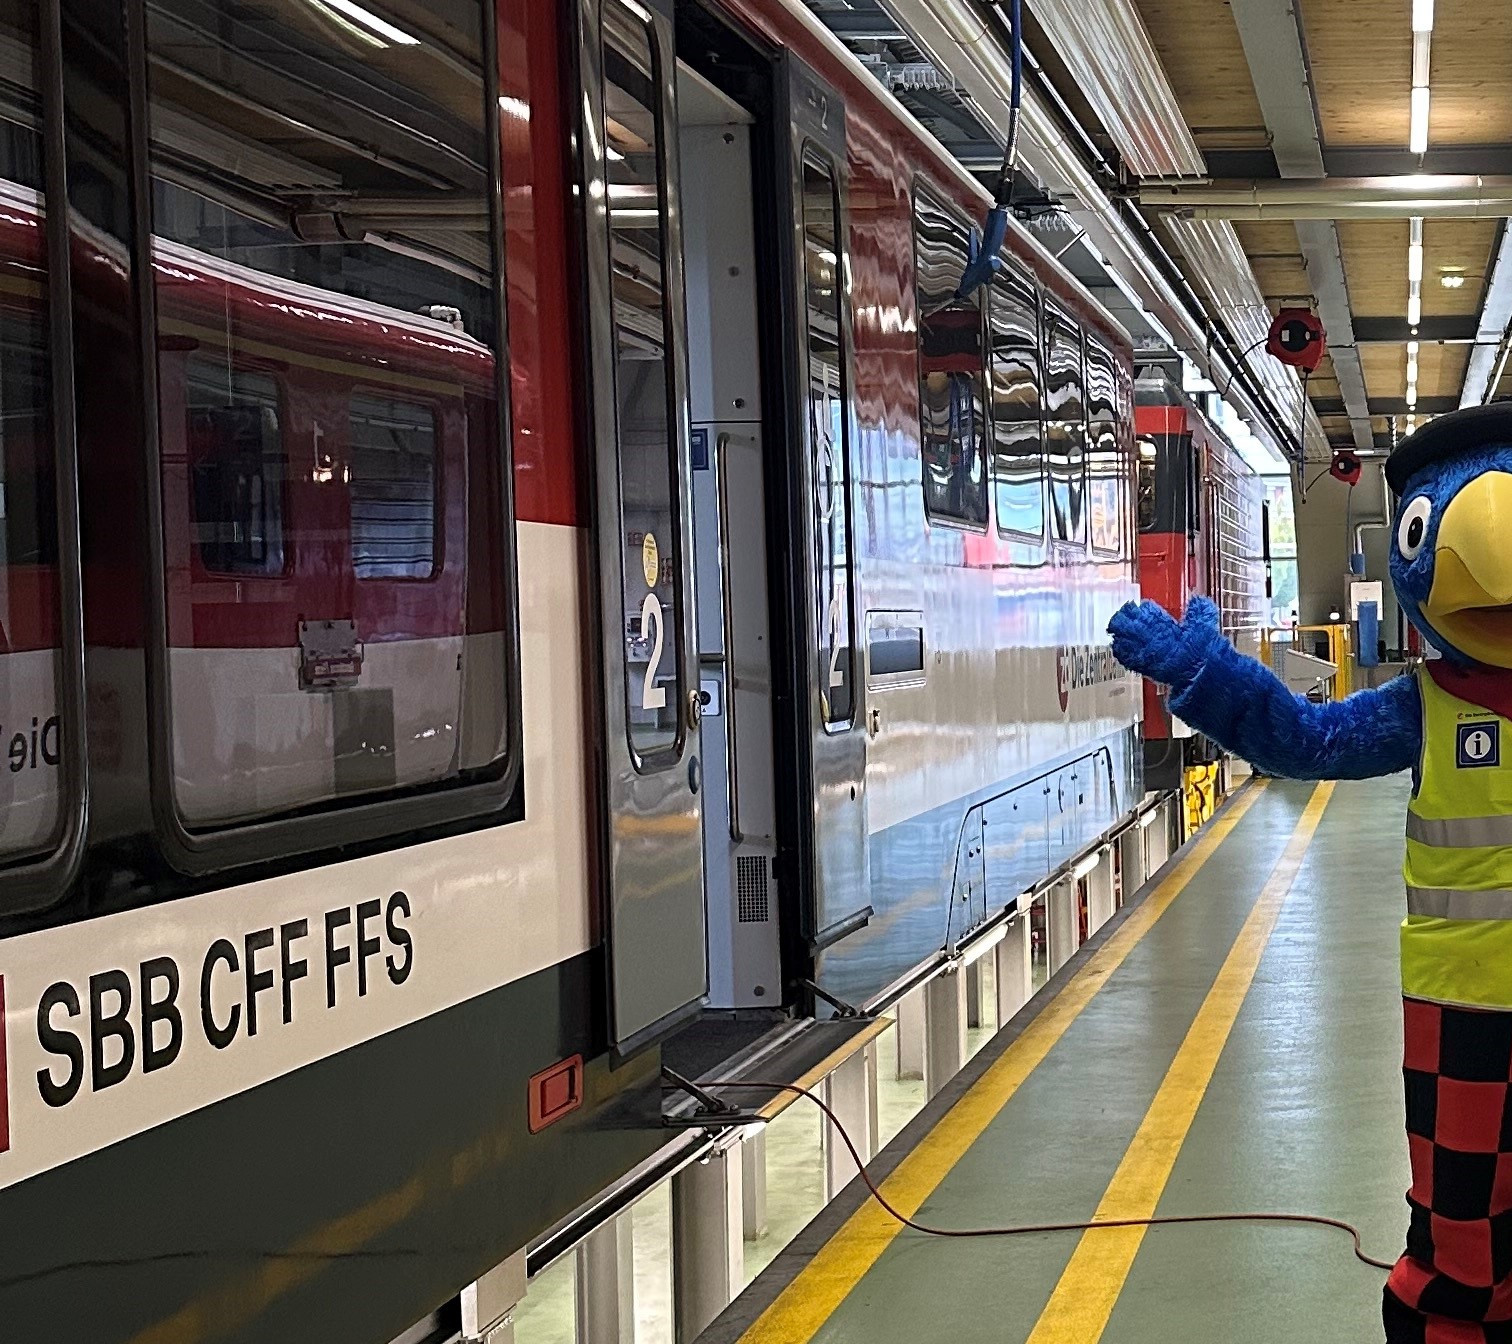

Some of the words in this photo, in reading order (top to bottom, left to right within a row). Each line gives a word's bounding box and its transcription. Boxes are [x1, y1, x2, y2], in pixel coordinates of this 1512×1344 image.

[641, 592, 667, 710] 2
[36, 956, 183, 1108] SBB
[200, 918, 308, 1050] CFF
[325, 890, 413, 1009] FFS
